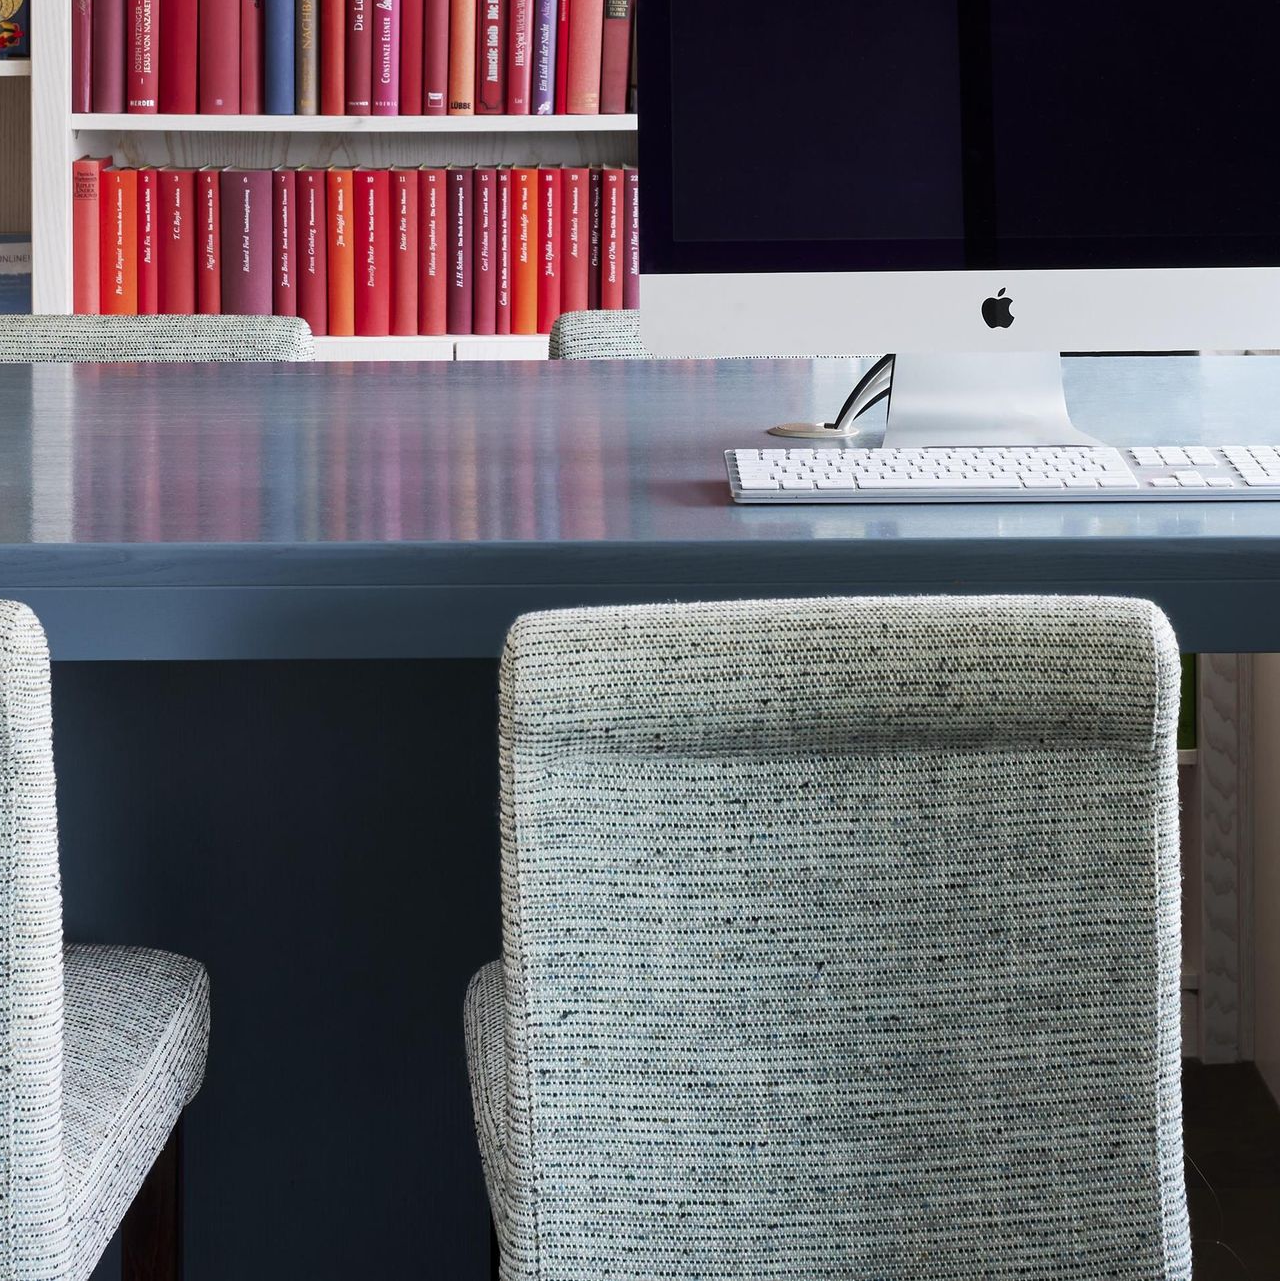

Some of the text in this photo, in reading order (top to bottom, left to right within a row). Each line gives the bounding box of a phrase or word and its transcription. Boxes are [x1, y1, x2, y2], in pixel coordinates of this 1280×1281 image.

[354, 14, 363, 31] Die
[381, 17, 391, 83] CONSTANZE ELSNER
[130, 99, 155, 107] HERDER
[546, 262, 554, 276] John
